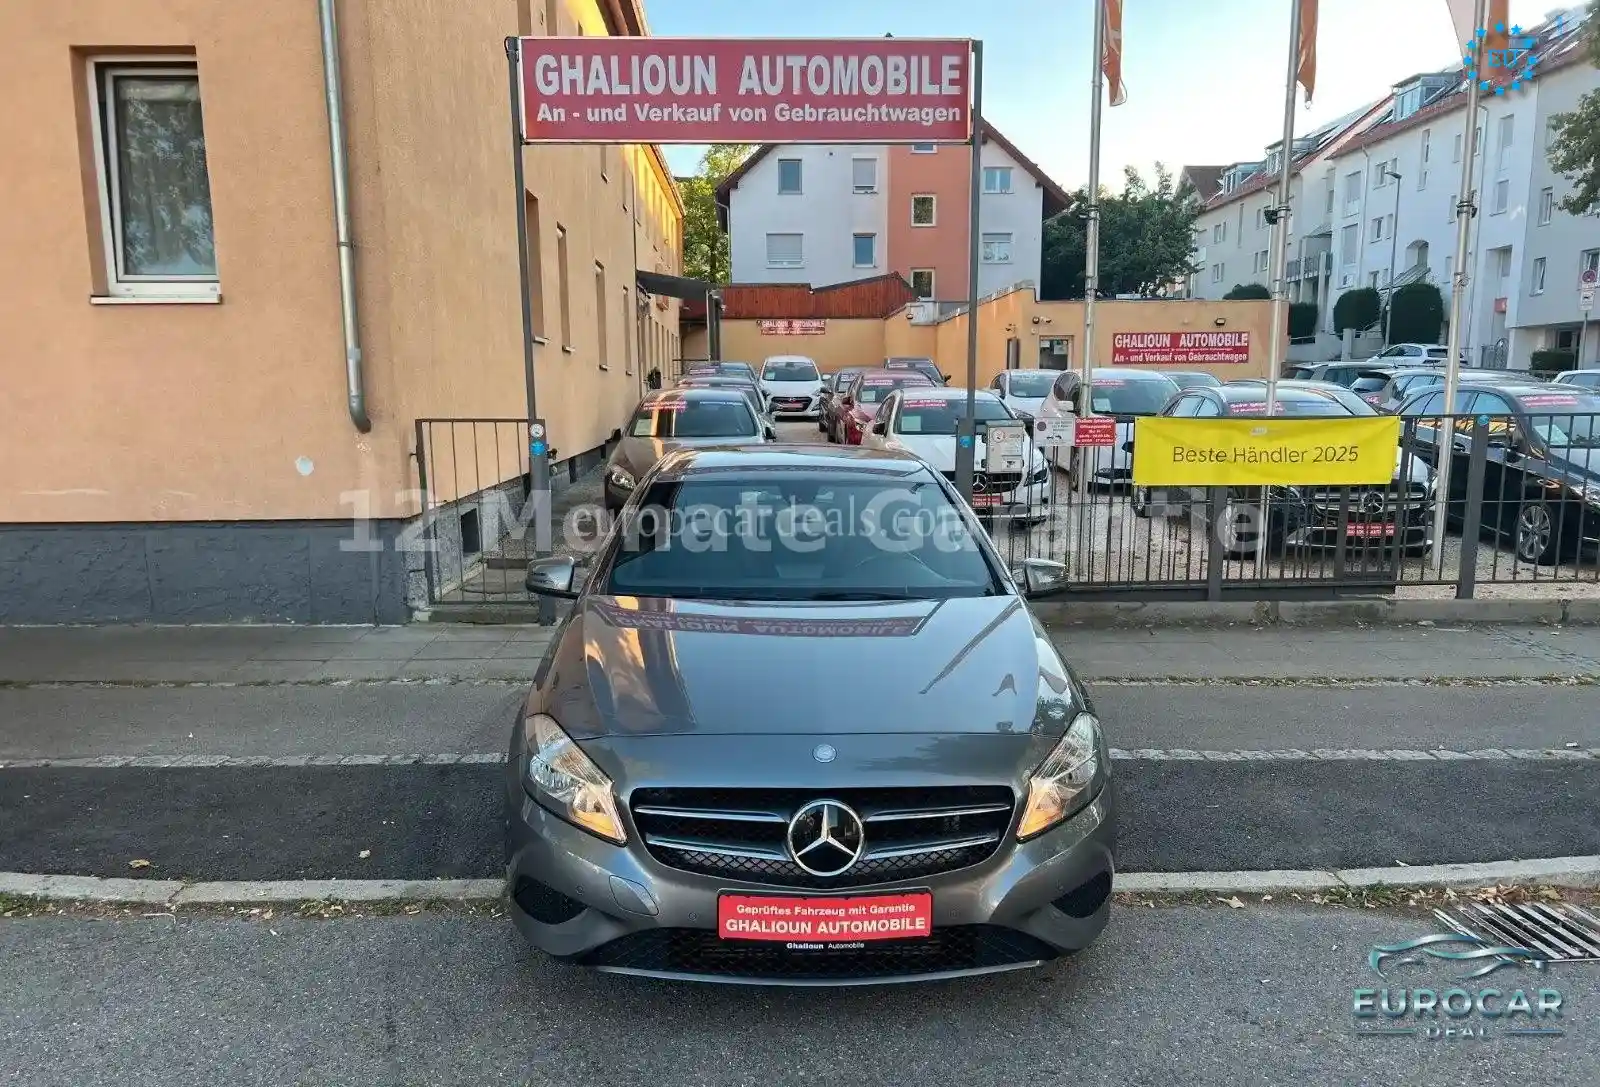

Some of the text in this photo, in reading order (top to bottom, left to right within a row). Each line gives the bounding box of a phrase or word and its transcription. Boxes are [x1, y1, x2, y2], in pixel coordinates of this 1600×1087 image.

[535, 54, 962, 96] GHALIOUN AUTOMOBILE
[537, 103, 566, 122] An
[586, 103, 627, 122] und
[634, 103, 722, 123] Verkauf
[729, 107, 767, 122] von
[774, 103, 961, 126] Gebrauchtwagen
[1115, 333, 1249, 348] GHALIOUN AUTOMOBILE
[1114, 353, 1124, 362] An
[1130, 353, 1143, 362] und
[1145, 352, 1173, 362] Verkauf
[1188, 352, 1247, 363] Gebrauchtwagen
[1173, 445, 1359, 463] Beste Händler 2025
[736, 904, 916, 917] Geprüftes Fahrzeug mit Garantie
[725, 917, 926, 934] GHALIOUN AUTOMOBILE
[786, 942, 824, 950] Ghalioun
